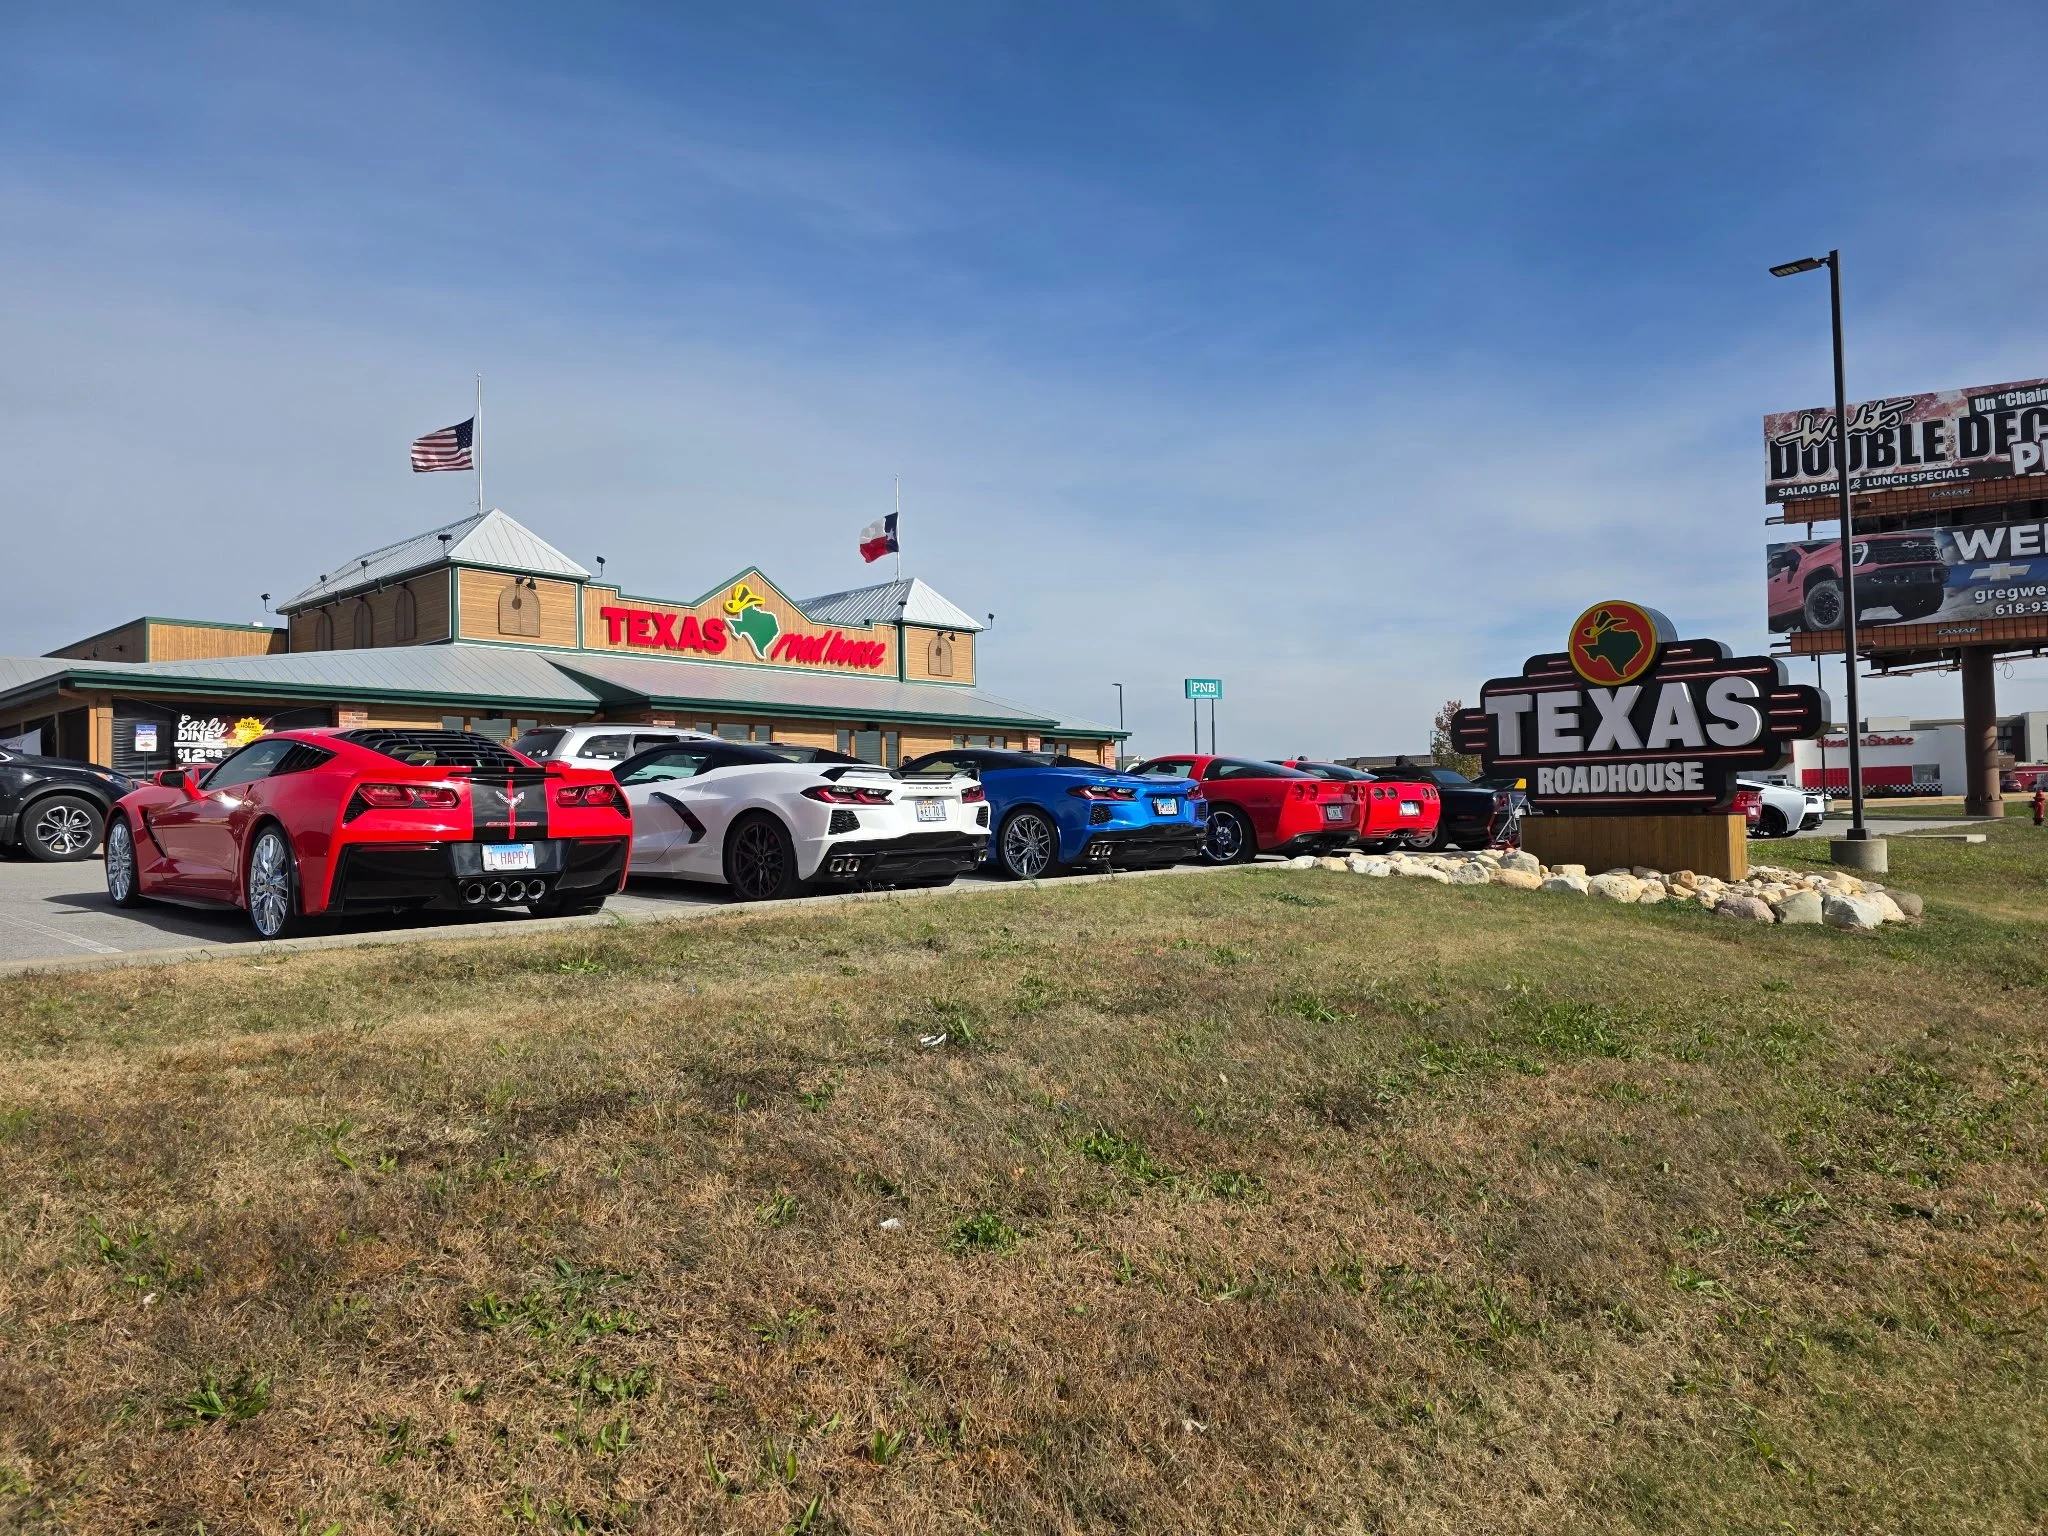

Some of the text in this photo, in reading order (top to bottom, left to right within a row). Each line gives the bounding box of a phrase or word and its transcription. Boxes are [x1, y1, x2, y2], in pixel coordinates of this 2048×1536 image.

[1974, 397, 1997, 413] Un
[1778, 467, 1970, 497] SALAD BA & LUNCH SPECIALS
[1952, 523, 2048, 560] WE
[600, 606, 727, 655] TEXAS
[1937, 627, 1979, 635] LAMAR
[1192, 682, 1216, 693] PNB
[178, 714, 228, 738] Early
[1485, 676, 1763, 756] TEXAS
[1537, 761, 1705, 795] ROADHOUSE
[500, 850, 530, 865] HAPPY
